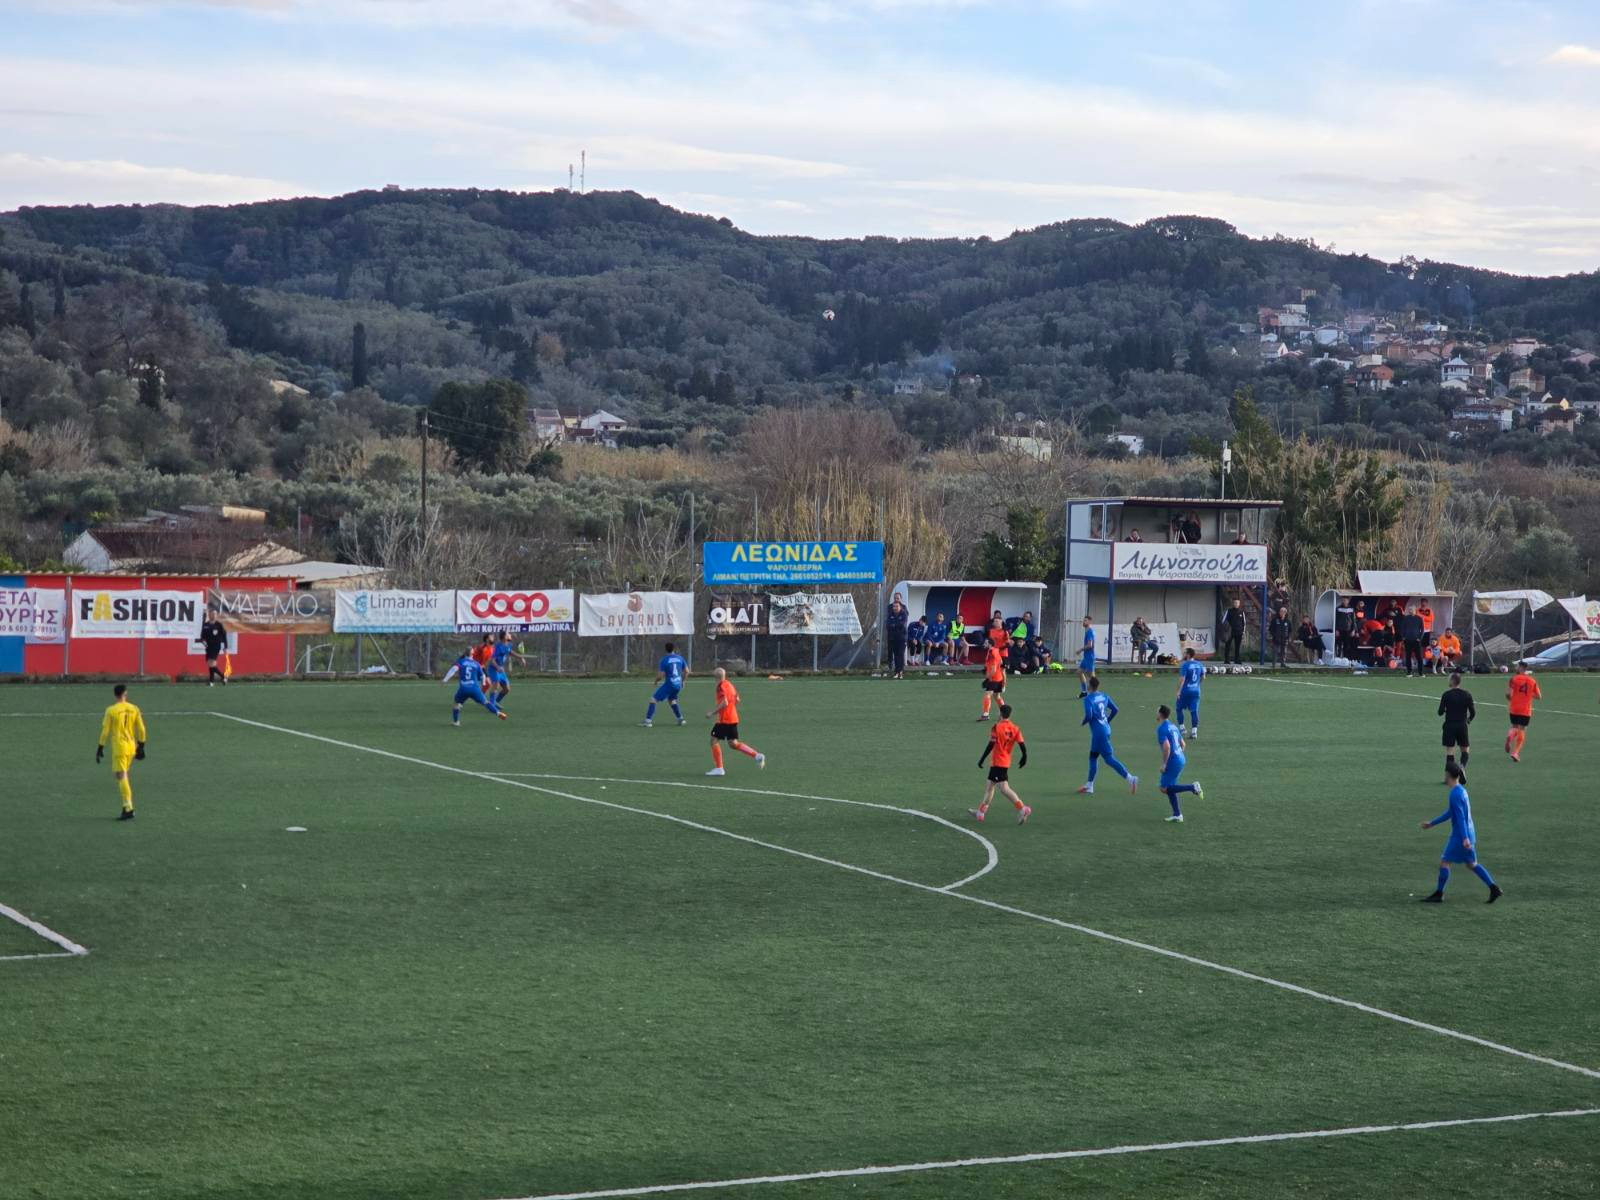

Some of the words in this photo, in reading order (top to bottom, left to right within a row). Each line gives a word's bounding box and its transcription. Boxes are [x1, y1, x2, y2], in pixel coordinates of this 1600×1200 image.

[731, 543, 858, 562] ΛΕΩΝΙΔΑΣ
[369, 593, 438, 609] Limanaki
[0, 608, 59, 625] ΥΡΗΣ
[708, 603, 763, 626] OLAT
